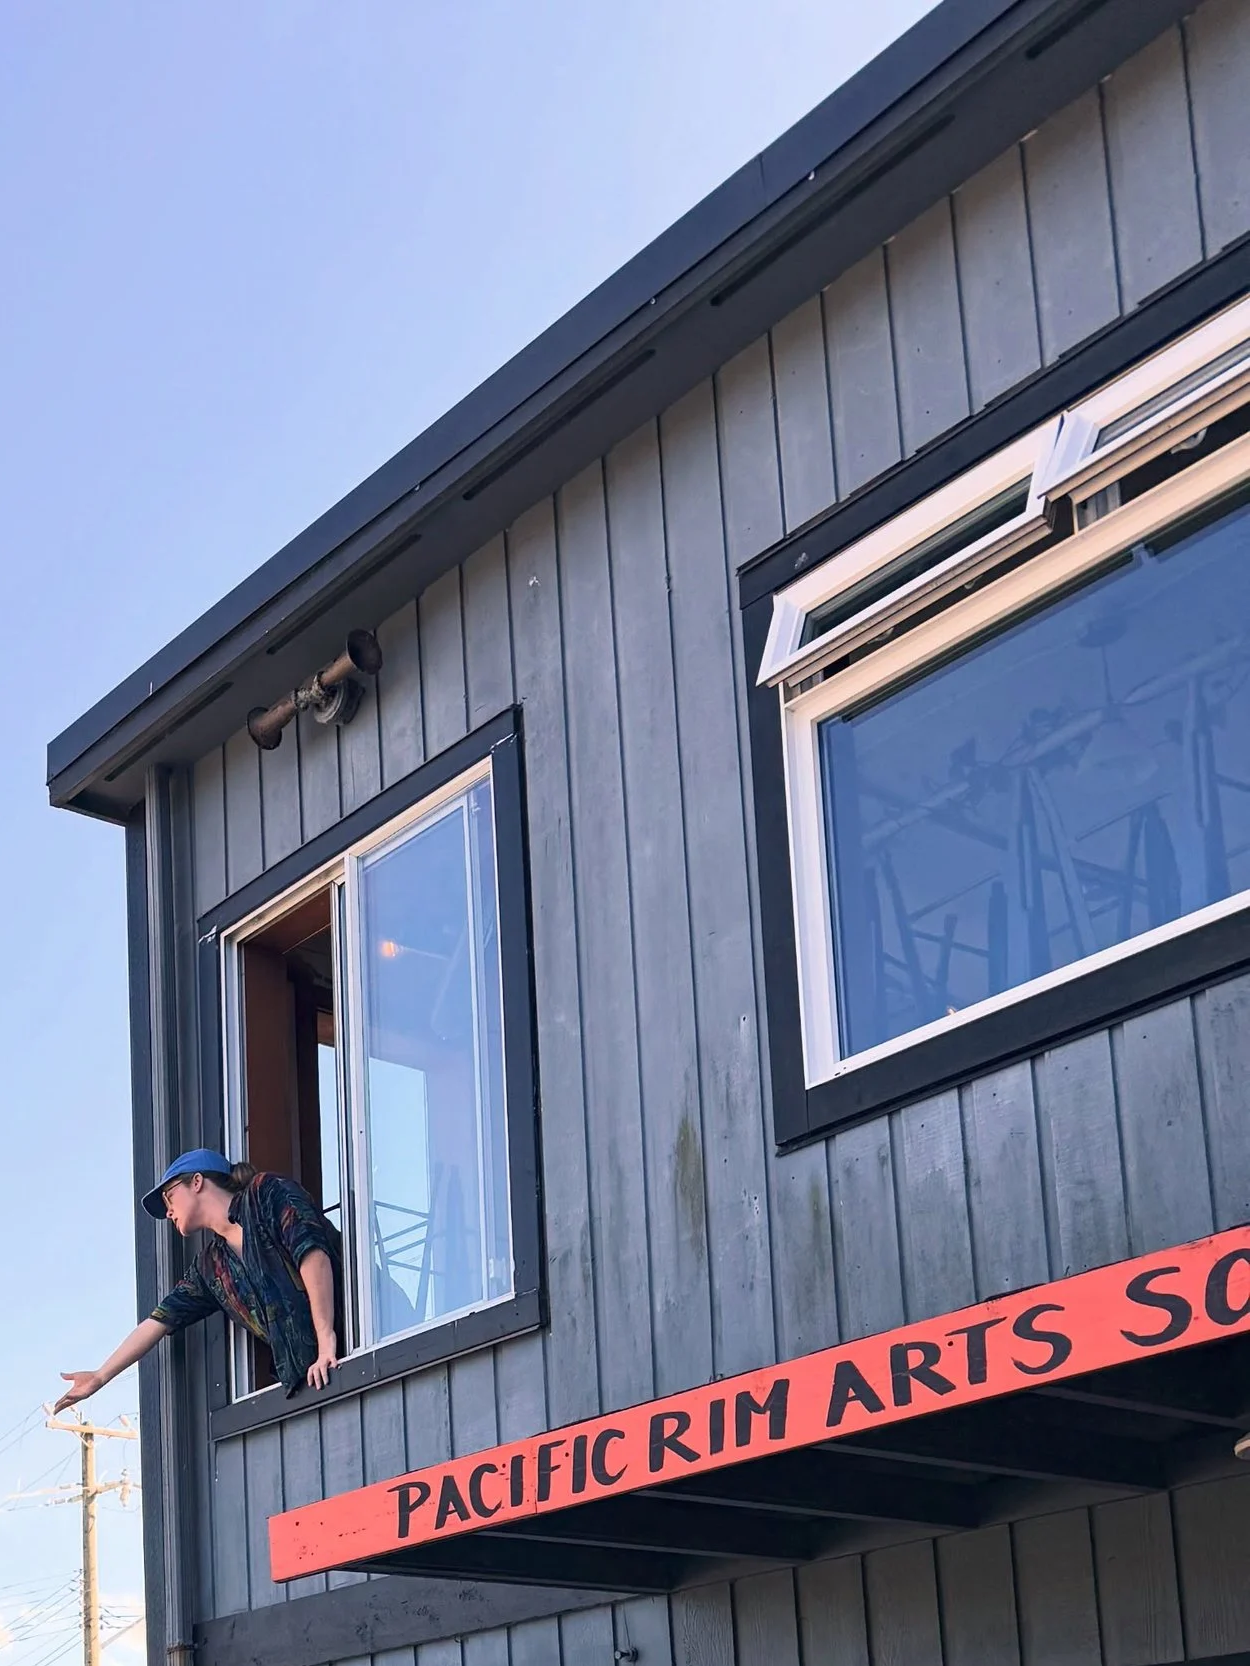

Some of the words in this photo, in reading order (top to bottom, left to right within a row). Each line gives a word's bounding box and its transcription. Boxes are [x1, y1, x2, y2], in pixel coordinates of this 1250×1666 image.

[387, 1429, 628, 1538] PACIFIC
[650, 1379, 790, 1472] RIM
[826, 1304, 1072, 1427] ARTS
